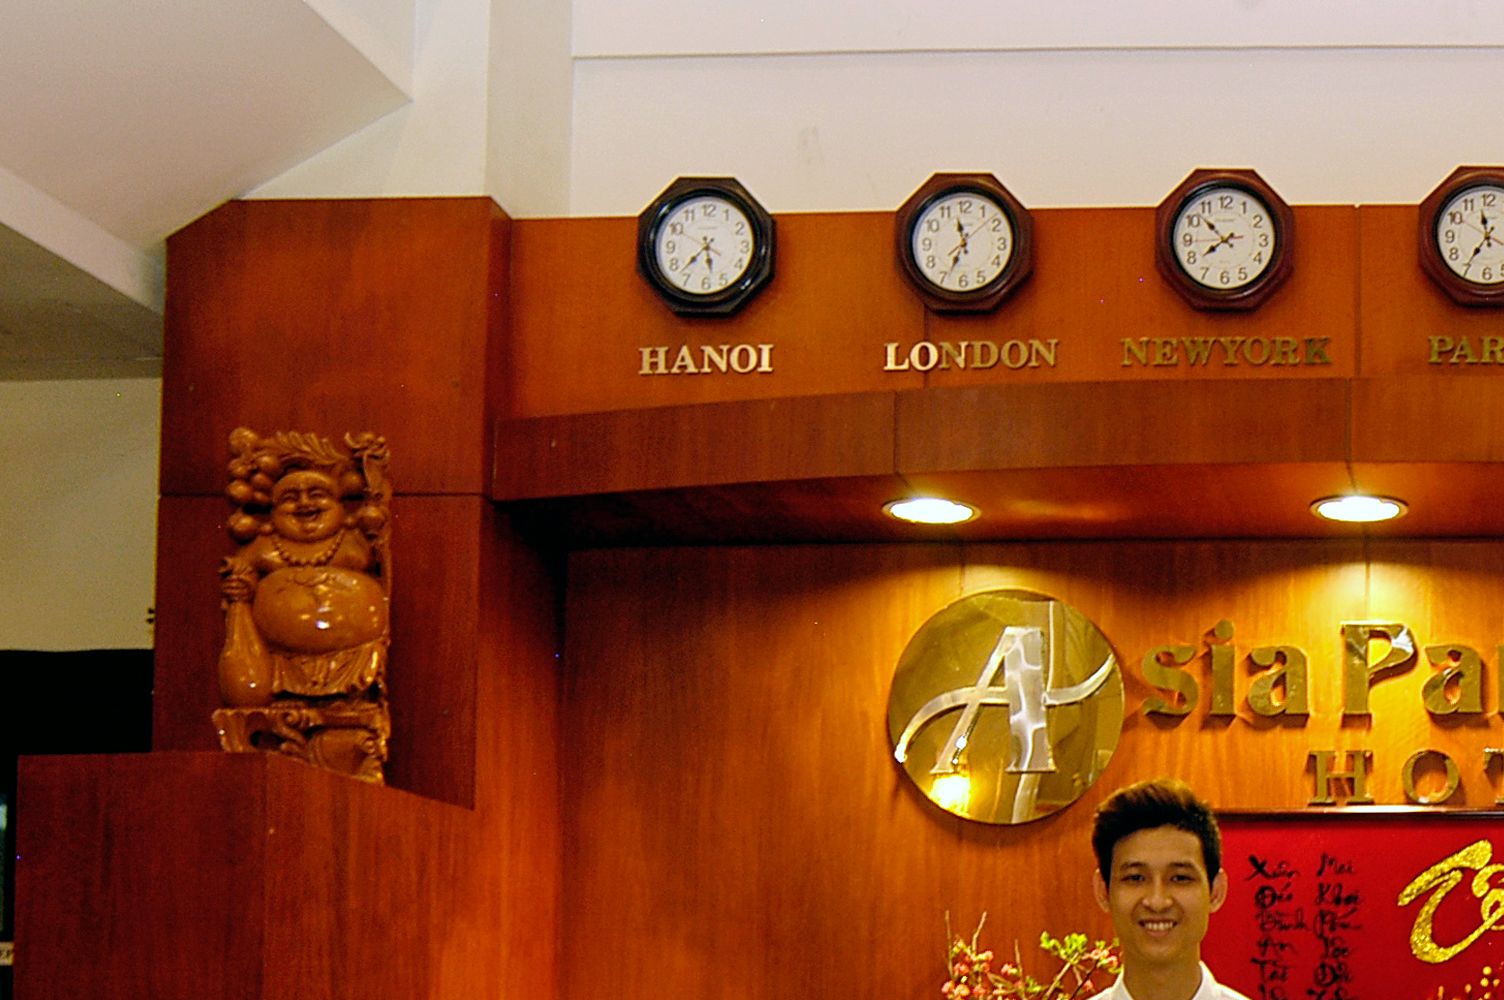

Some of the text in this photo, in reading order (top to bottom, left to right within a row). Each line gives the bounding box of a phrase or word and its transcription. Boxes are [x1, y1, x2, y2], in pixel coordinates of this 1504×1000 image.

[957, 200, 973, 214] 12
[1199, 200, 1212, 214] 11
[1218, 195, 1234, 209] 12
[1462, 198, 1474, 211] 11
[1481, 193, 1496, 207] 12
[701, 203, 717, 217] 12
[723, 208, 729, 221] 1
[939, 205, 951, 219] 11
[979, 204, 986, 218] 1
[1241, 201, 1247, 214] 1
[683, 209, 695, 221] 11
[1185, 213, 1202, 228] 10
[1253, 214, 1263, 229] 2
[1447, 211, 1464, 225] 10
[669, 222, 684, 235] 10
[735, 221, 745, 236] 2
[926, 218, 940, 233] 10
[992, 218, 1002, 232] 2
[997, 236, 1007, 251] 3
[1182, 233, 1193, 247] 9
[1259, 233, 1269, 248] 3
[1445, 229, 1455, 244] 9
[666, 240, 676, 254] 9
[740, 239, 750, 254] 3
[922, 237, 932, 252] 9
[991, 254, 1001, 268] 4
[1186, 250, 1197, 265] 8
[1253, 251, 1262, 265] 4
[1449, 247, 1459, 261] 8
[669, 257, 680, 272] 8
[733, 258, 743, 269] 4
[926, 255, 936, 269] 8
[976, 270, 986, 284] 5
[1200, 266, 1210, 281] 7
[1220, 270, 1230, 285] 6
[1238, 267, 1248, 281] 5
[1462, 263, 1472, 278] 7
[1482, 266, 1493, 281] 6
[682, 273, 691, 288] 7
[701, 276, 711, 290] 6
[719, 273, 729, 286] 5
[937, 271, 948, 286] 7
[958, 274, 969, 288] 6
[639, 344, 774, 375] HANOI
[883, 338, 1059, 371] LONDON
